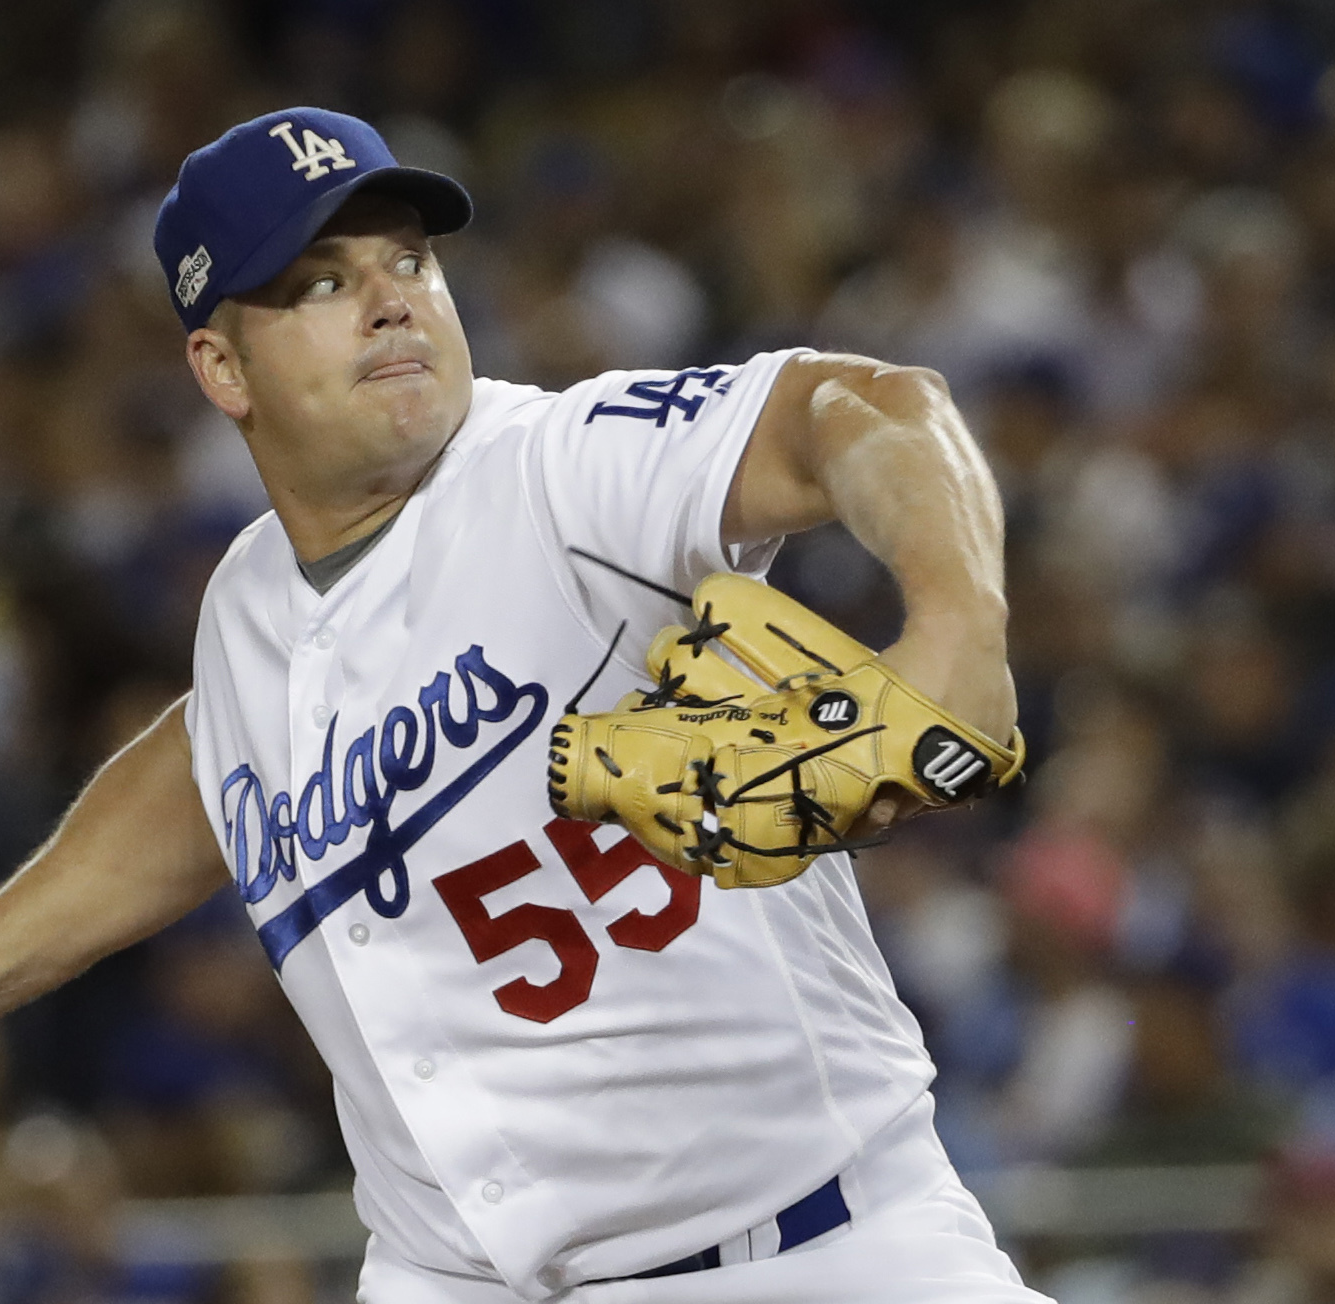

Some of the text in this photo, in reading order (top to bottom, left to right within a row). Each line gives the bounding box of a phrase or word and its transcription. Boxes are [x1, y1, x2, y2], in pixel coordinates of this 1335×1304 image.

[268, 121, 356, 181] LA
[584, 368, 734, 428] LA
[221, 644, 523, 918] Dodgers
[432, 817, 701, 1024] 55
